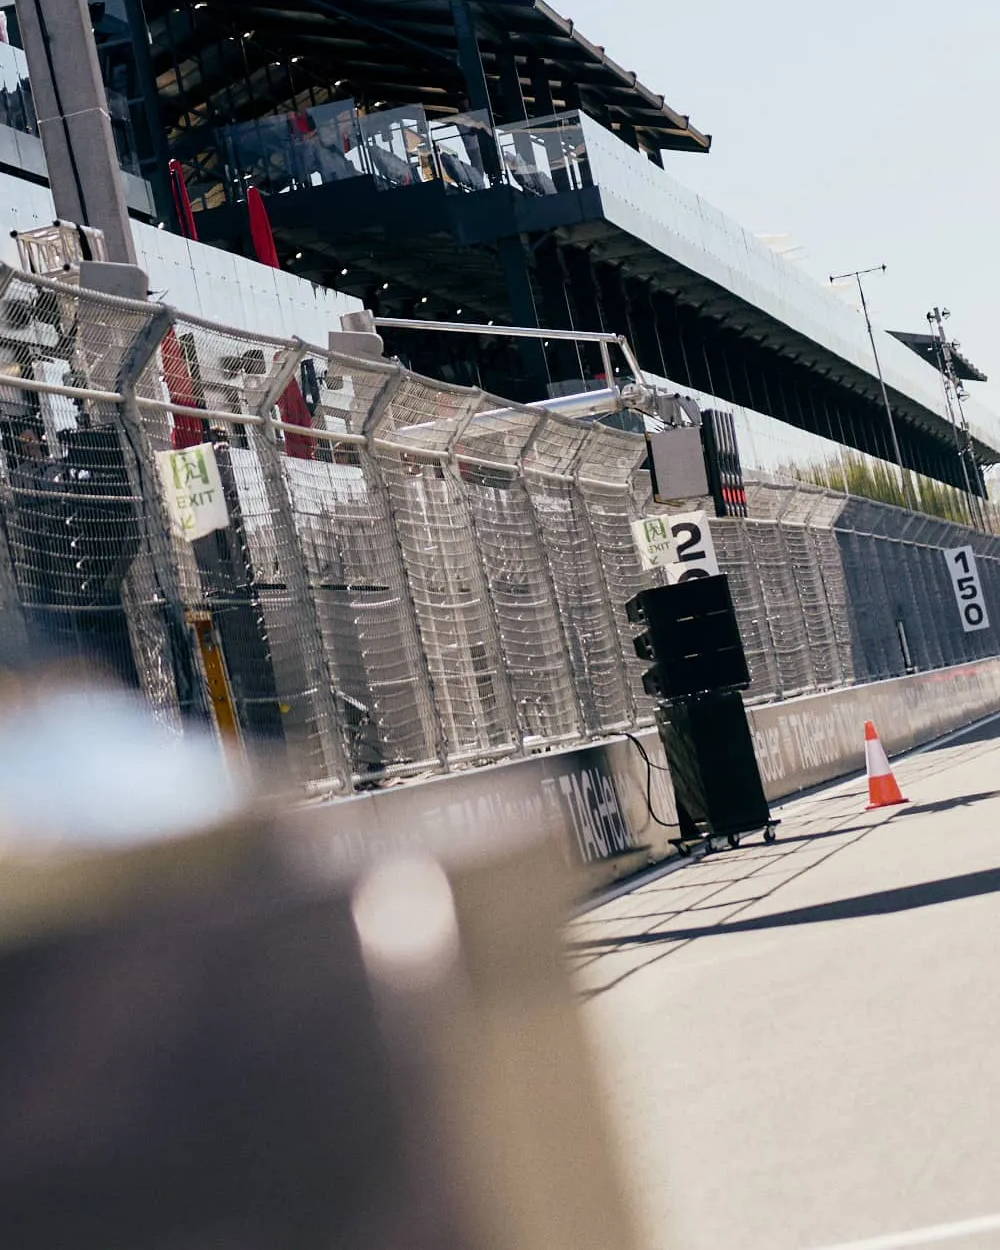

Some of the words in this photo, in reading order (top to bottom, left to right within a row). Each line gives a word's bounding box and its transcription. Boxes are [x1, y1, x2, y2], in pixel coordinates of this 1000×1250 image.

[177, 490, 215, 507] EXIT
[647, 541, 671, 554] EXIT
[954, 551, 983, 626] 150
